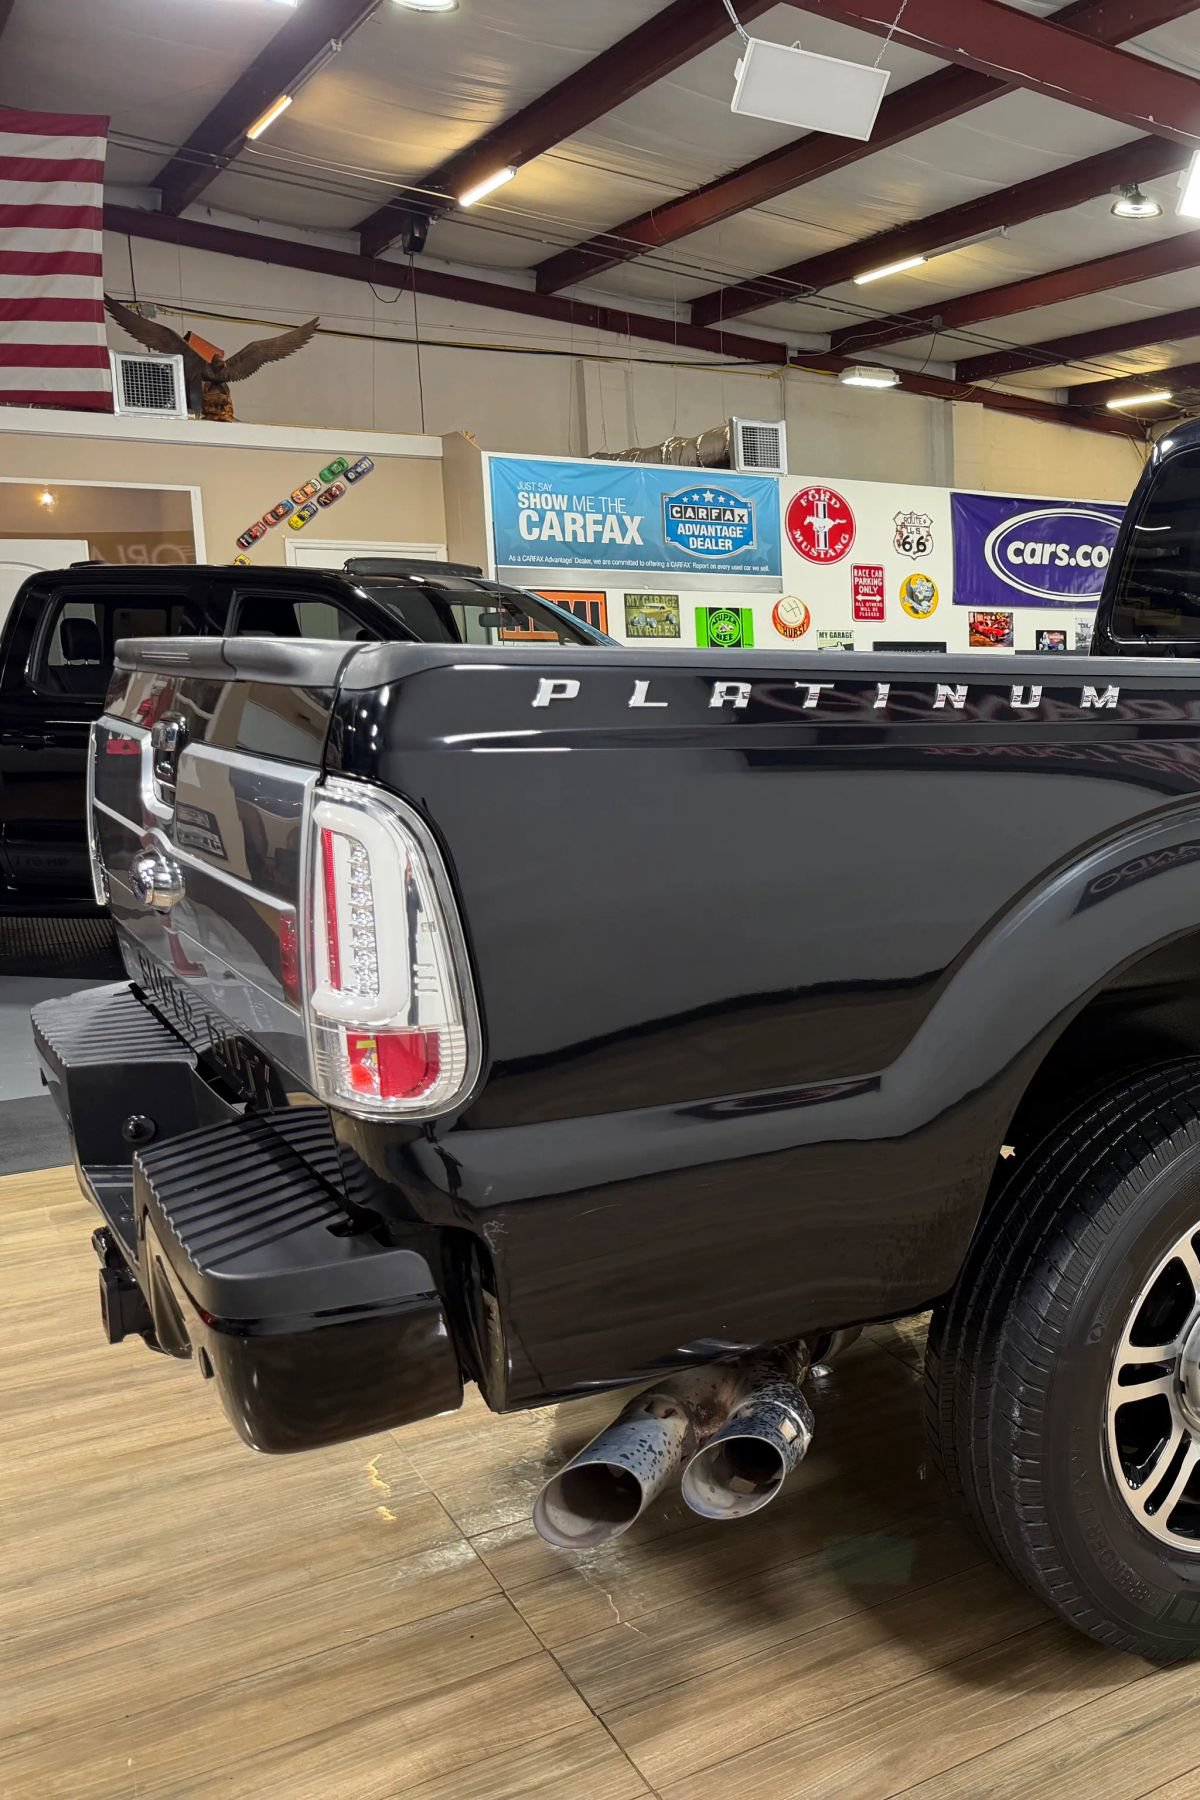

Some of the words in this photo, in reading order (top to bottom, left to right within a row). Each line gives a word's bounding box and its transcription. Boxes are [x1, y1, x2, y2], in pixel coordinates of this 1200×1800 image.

[517, 482, 536, 491] JUST
[538, 483, 553, 492] SAY
[517, 491, 568, 511] SHOW
[572, 495, 596, 513] ME
[598, 496, 627, 514] THE
[800, 489, 841, 509] FORD
[671, 505, 746, 523] CARFAX
[903, 516, 923, 525] ROUTE
[518, 509, 644, 545] CARFAX
[677, 523, 744, 538] ADVANTAGE
[689, 537, 733, 550] DEALER
[793, 529, 849, 559] MUSTANG
[901, 534, 927, 553] 66
[1007, 541, 1114, 569] cars.co
[574, 557, 593, 565] Dealer,
[612, 559, 639, 567] committed
[645, 561, 665, 569] offering
[670, 561, 691, 569] CARFAX
[692, 562, 709, 570] Report
[853, 569, 869, 577] RACE
[870, 569, 883, 578] CAR
[854, 577, 883, 586] PARKING
[858, 586, 879, 594] ONLY
[626, 595, 640, 607] MY
[642, 595, 678, 608] GARAGE
[783, 622, 806, 638] HURST
[532, 678, 1120, 709] PLATINUM
